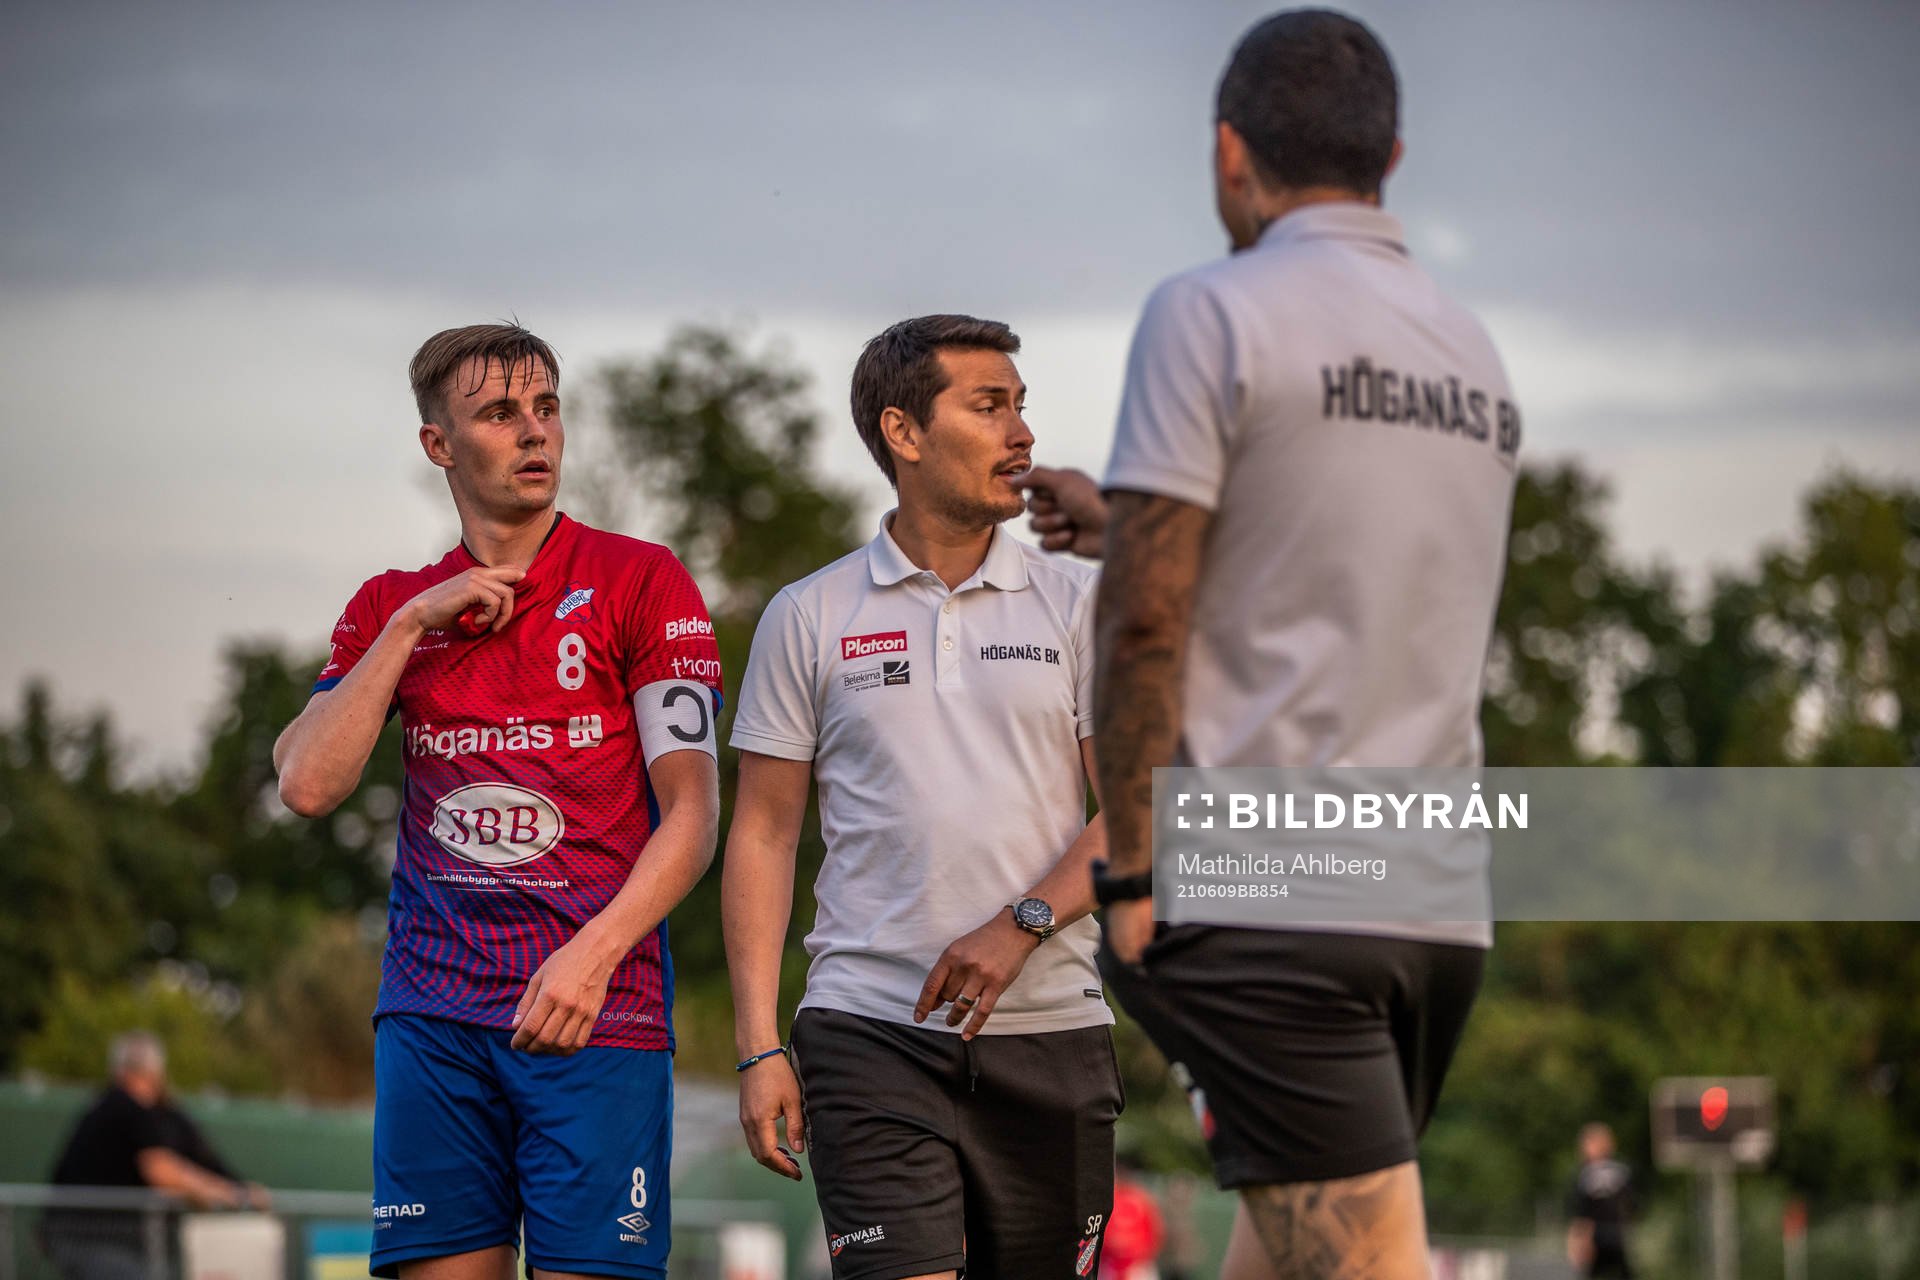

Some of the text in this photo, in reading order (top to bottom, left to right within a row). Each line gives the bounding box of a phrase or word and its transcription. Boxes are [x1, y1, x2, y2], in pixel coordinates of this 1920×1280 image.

[1321, 356, 1489, 443] HÖGANÄS
[845, 638, 905, 657] Platcon
[981, 644, 1060, 665] HÖGANÄS BK
[556, 632, 587, 691] 8
[671, 656, 720, 678] thorn
[844, 671, 880, 687] Belekima
[448, 806, 540, 845] SBB
[630, 1166, 647, 1209] 8
[1085, 1214, 1103, 1235] SR
